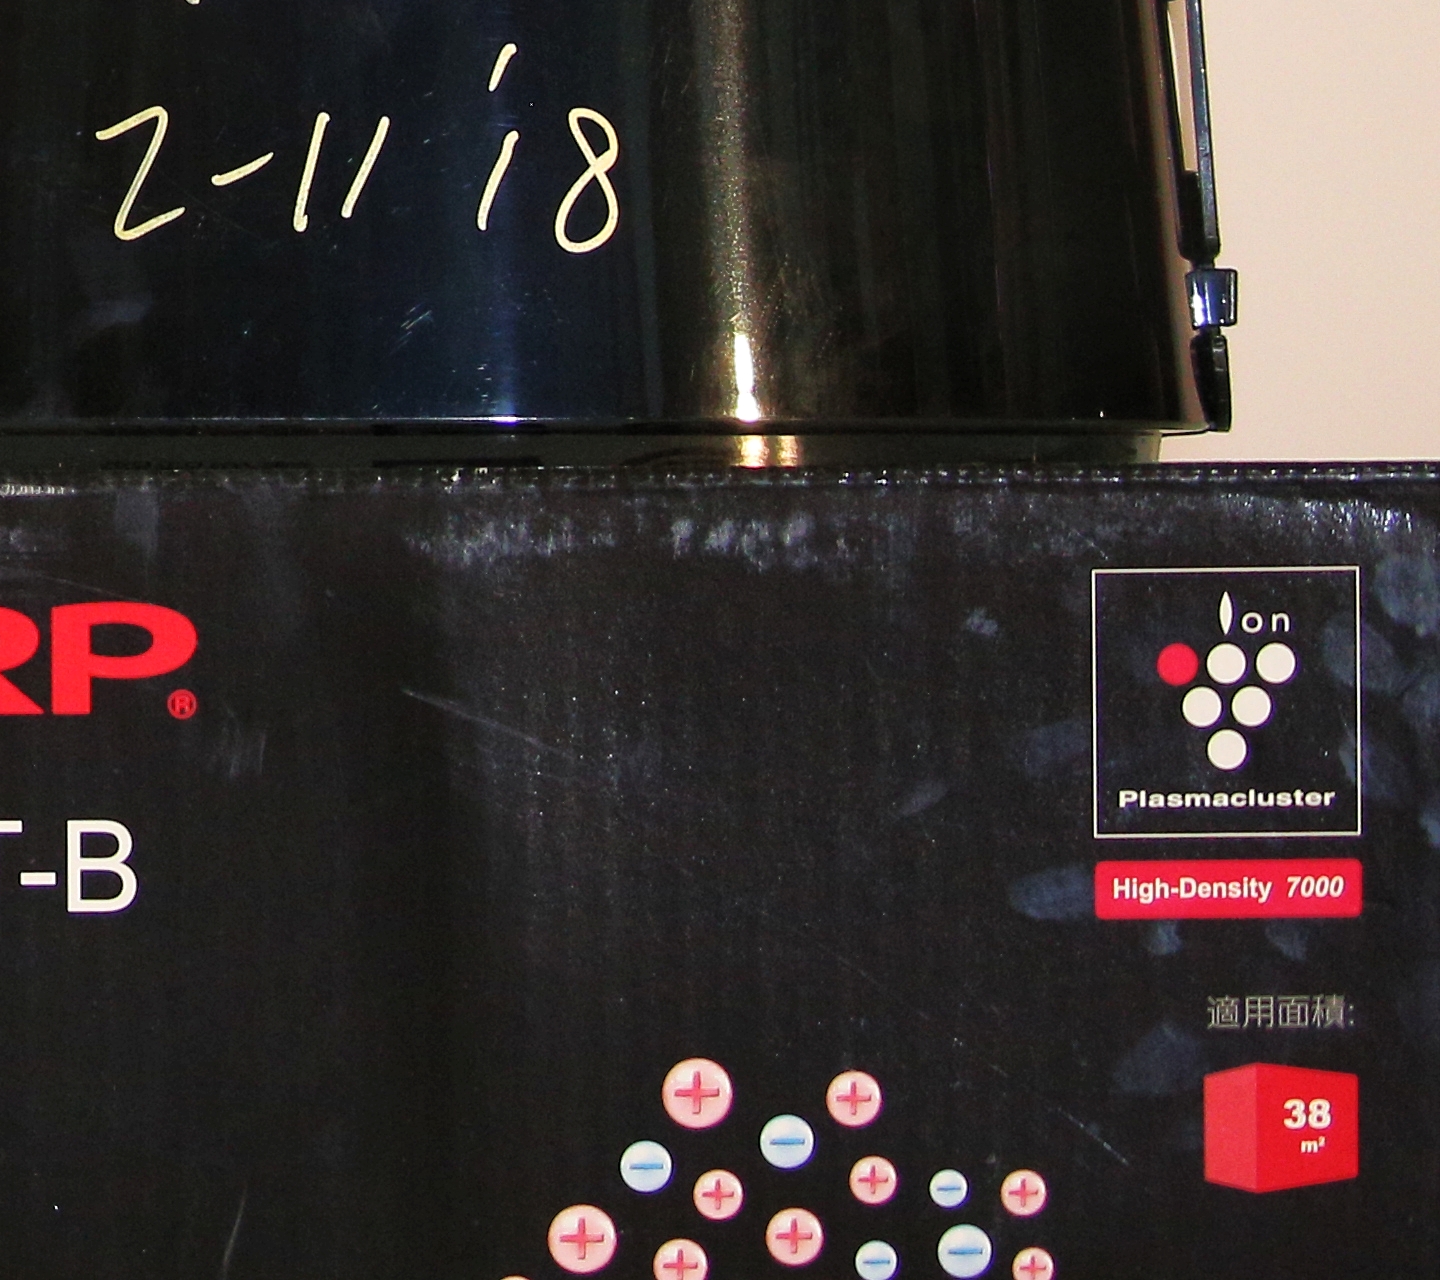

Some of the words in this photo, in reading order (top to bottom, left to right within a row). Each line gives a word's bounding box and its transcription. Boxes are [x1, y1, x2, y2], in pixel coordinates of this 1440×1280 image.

[1219, 591, 1291, 636] Ion
[1118, 788, 1338, 809] Plasmacluster
[1113, 876, 1274, 907] High-Density
[1286, 875, 1347, 899] 7000
[1283, 1098, 1332, 1130] 38
